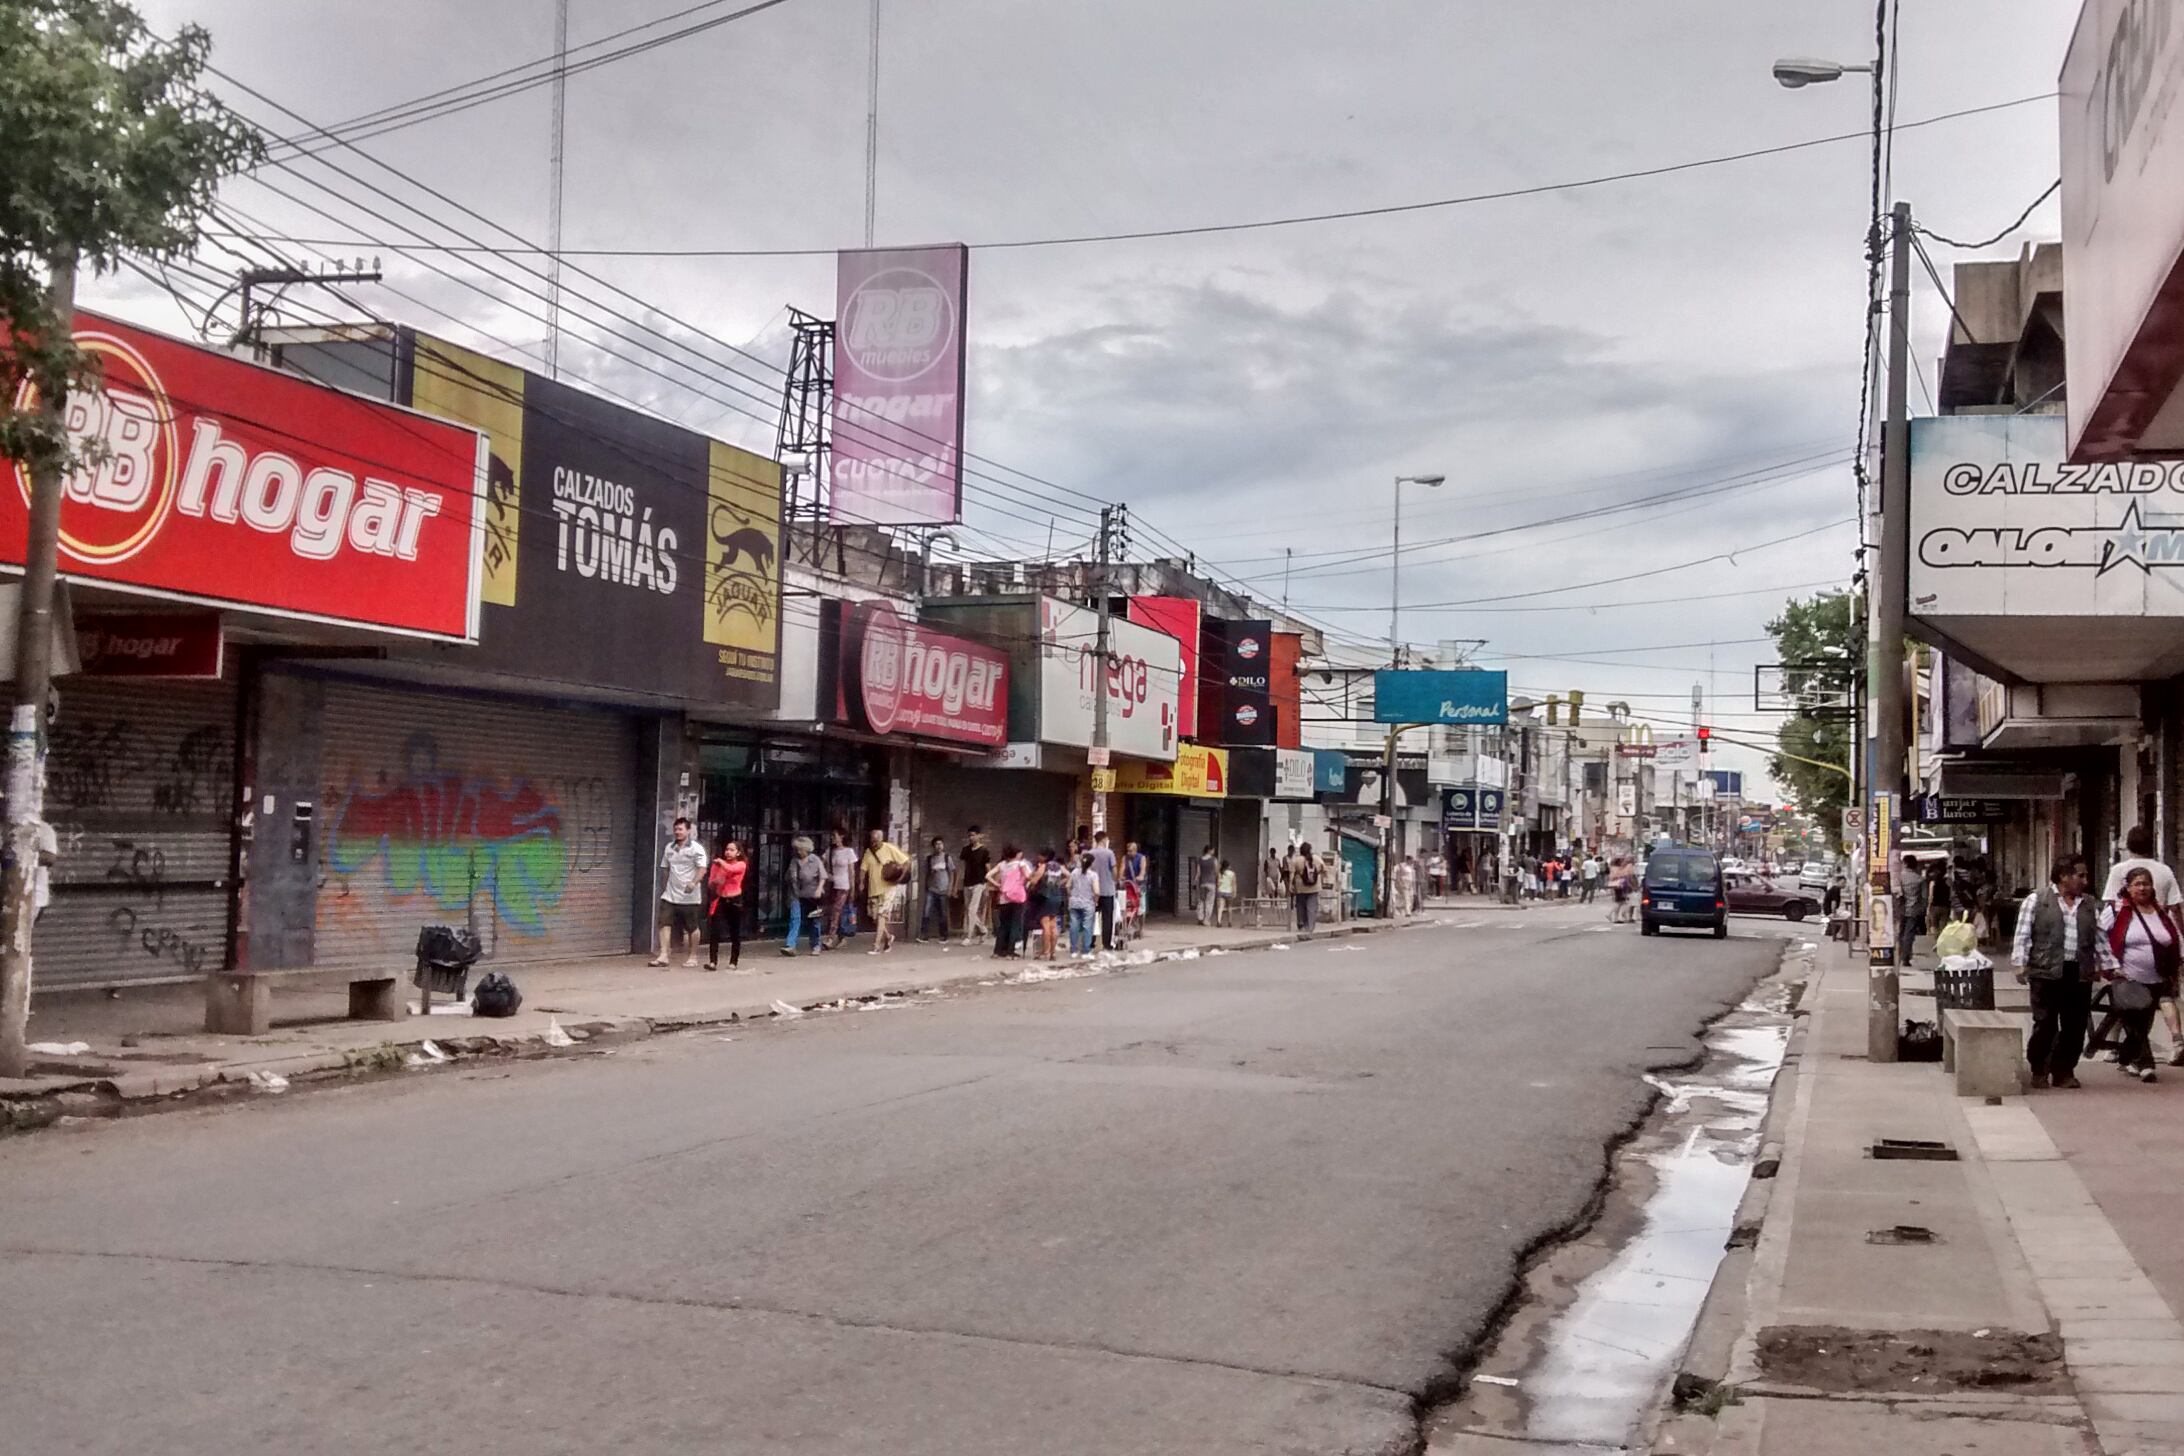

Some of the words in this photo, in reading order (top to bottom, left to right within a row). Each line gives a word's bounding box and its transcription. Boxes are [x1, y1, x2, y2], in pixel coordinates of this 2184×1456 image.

[849, 287, 942, 349] RB
[836, 393, 956, 422] hogar
[177, 417, 443, 561] hogar
[553, 466, 634, 516] CALZADOS
[552, 498, 678, 594] TOMÁS
[105, 634, 183, 658] hogar
[866, 626, 899, 692] RB
[903, 626, 1004, 715] hogar
[1238, 676, 1266, 685] DILO
[1439, 701, 1500, 718] Personal
